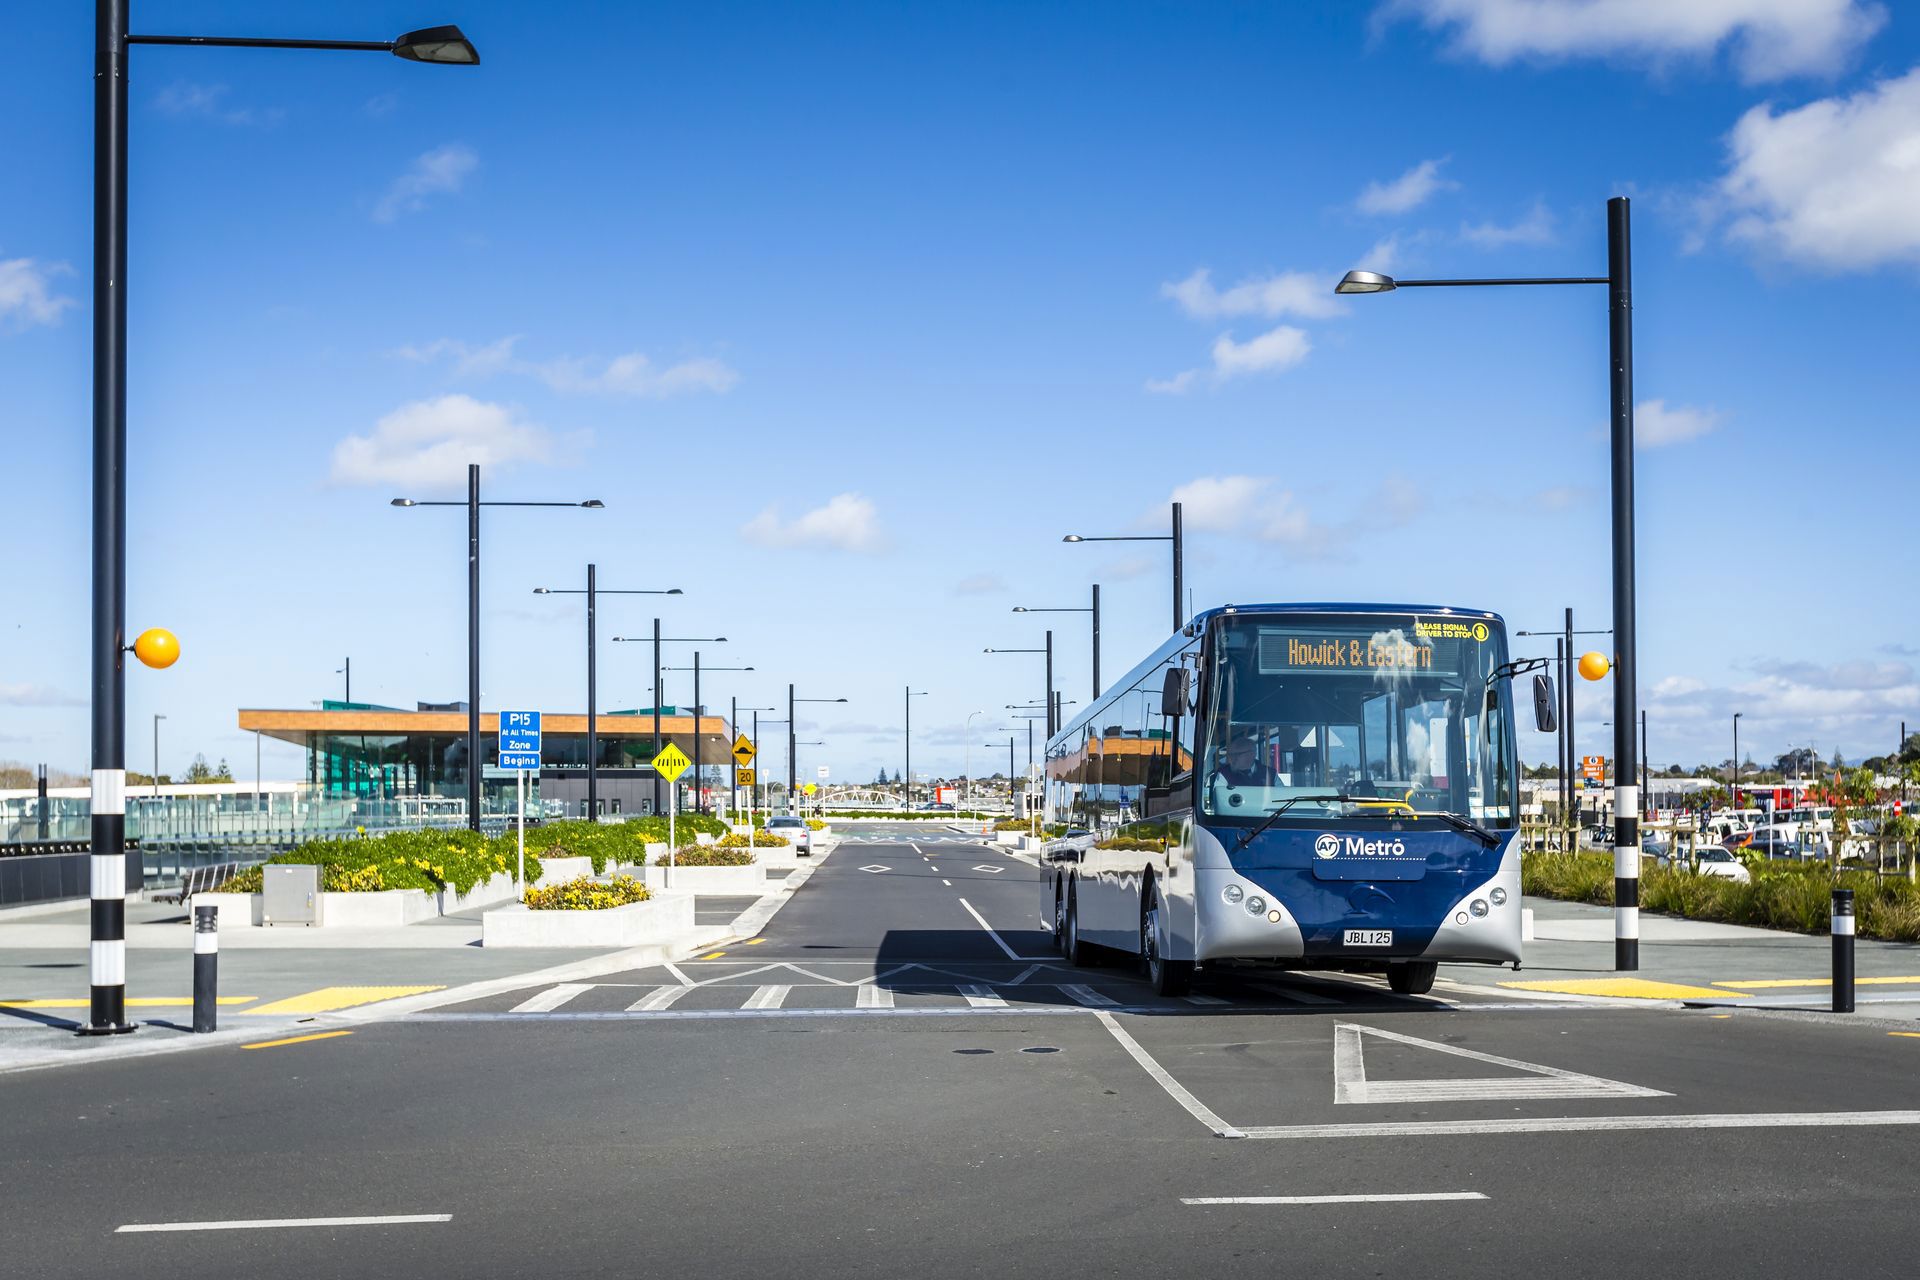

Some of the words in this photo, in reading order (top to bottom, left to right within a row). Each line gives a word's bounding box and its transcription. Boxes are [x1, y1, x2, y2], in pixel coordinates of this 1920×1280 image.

[1442, 623, 1468, 631] SIGNAL
[1288, 638, 1346, 666] Howick
[1349, 640, 1363, 666] &
[1367, 640, 1431, 667] Eastern
[509, 713, 531, 726] P15
[520, 729, 538, 737] Times
[509, 740, 531, 750] Zone
[503, 756, 536, 767] Begins
[740, 772, 752, 782] 20
